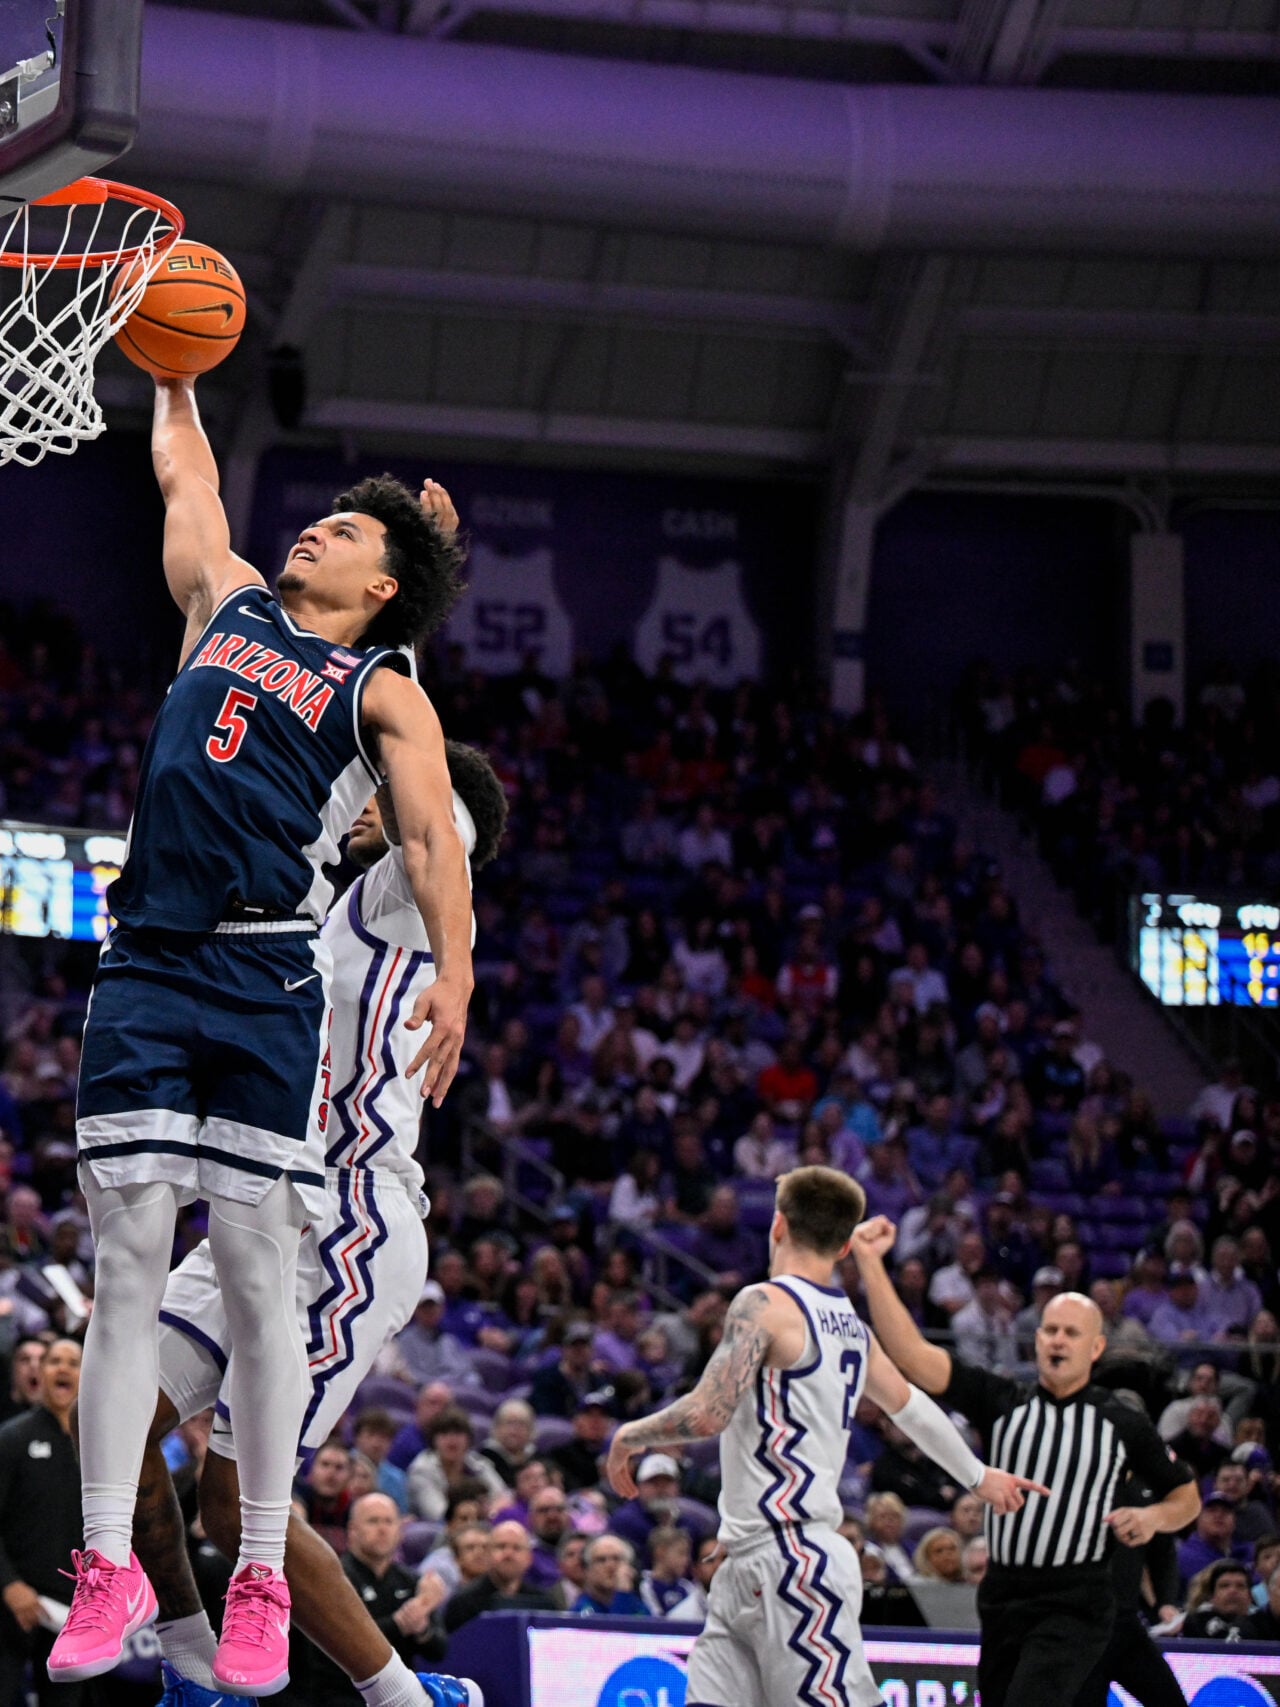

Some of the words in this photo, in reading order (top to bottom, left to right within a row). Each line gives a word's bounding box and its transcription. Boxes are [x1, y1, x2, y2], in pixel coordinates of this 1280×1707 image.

[167, 254, 234, 281] ELITE
[476, 602, 546, 654] 52
[661, 612, 733, 667] 54
[189, 632, 336, 733] ARIZONA
[206, 686, 258, 763] 5
